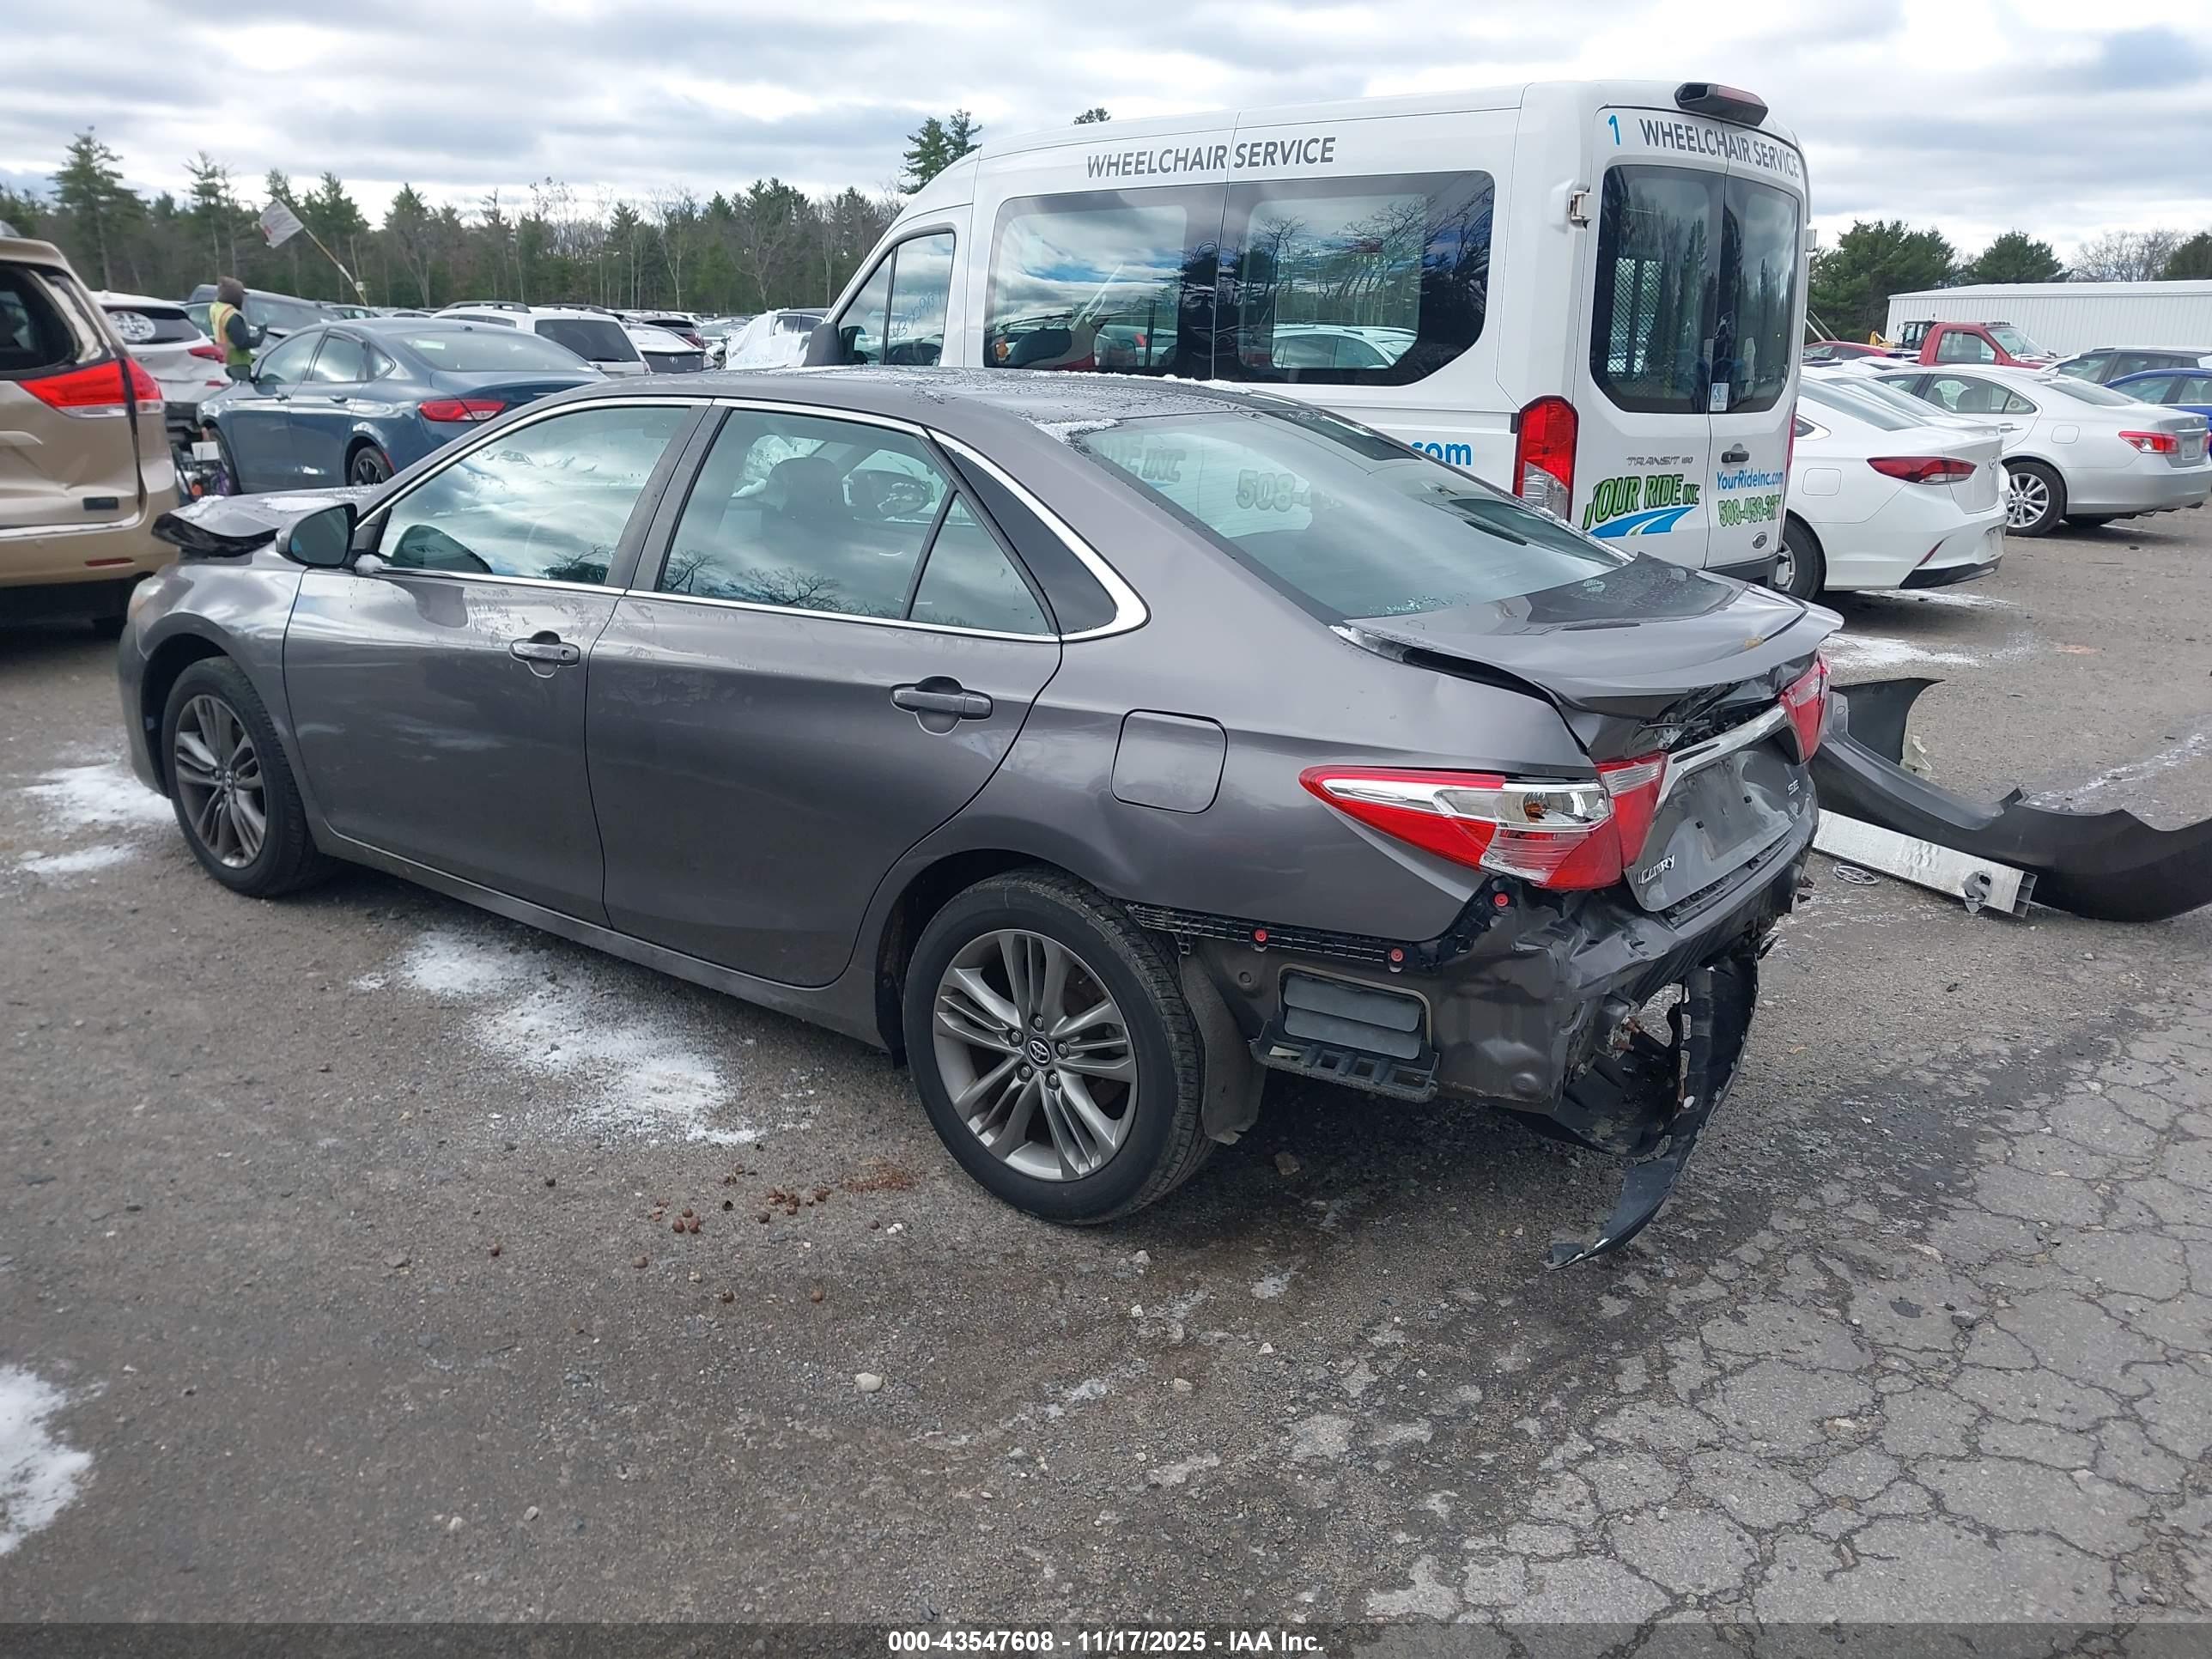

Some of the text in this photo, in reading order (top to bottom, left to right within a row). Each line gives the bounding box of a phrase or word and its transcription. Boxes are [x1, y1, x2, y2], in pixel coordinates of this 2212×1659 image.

[1607, 114, 1621, 146] 1
[1085, 137, 1337, 179] WHEELCHAIR SERVICE
[1639, 118, 1800, 179] WHEELCHAIR SERVICE
[1626, 456, 1680, 465] TRANSIT
[1644, 474, 1684, 509] RIDE
[1683, 483, 1700, 505] INC
